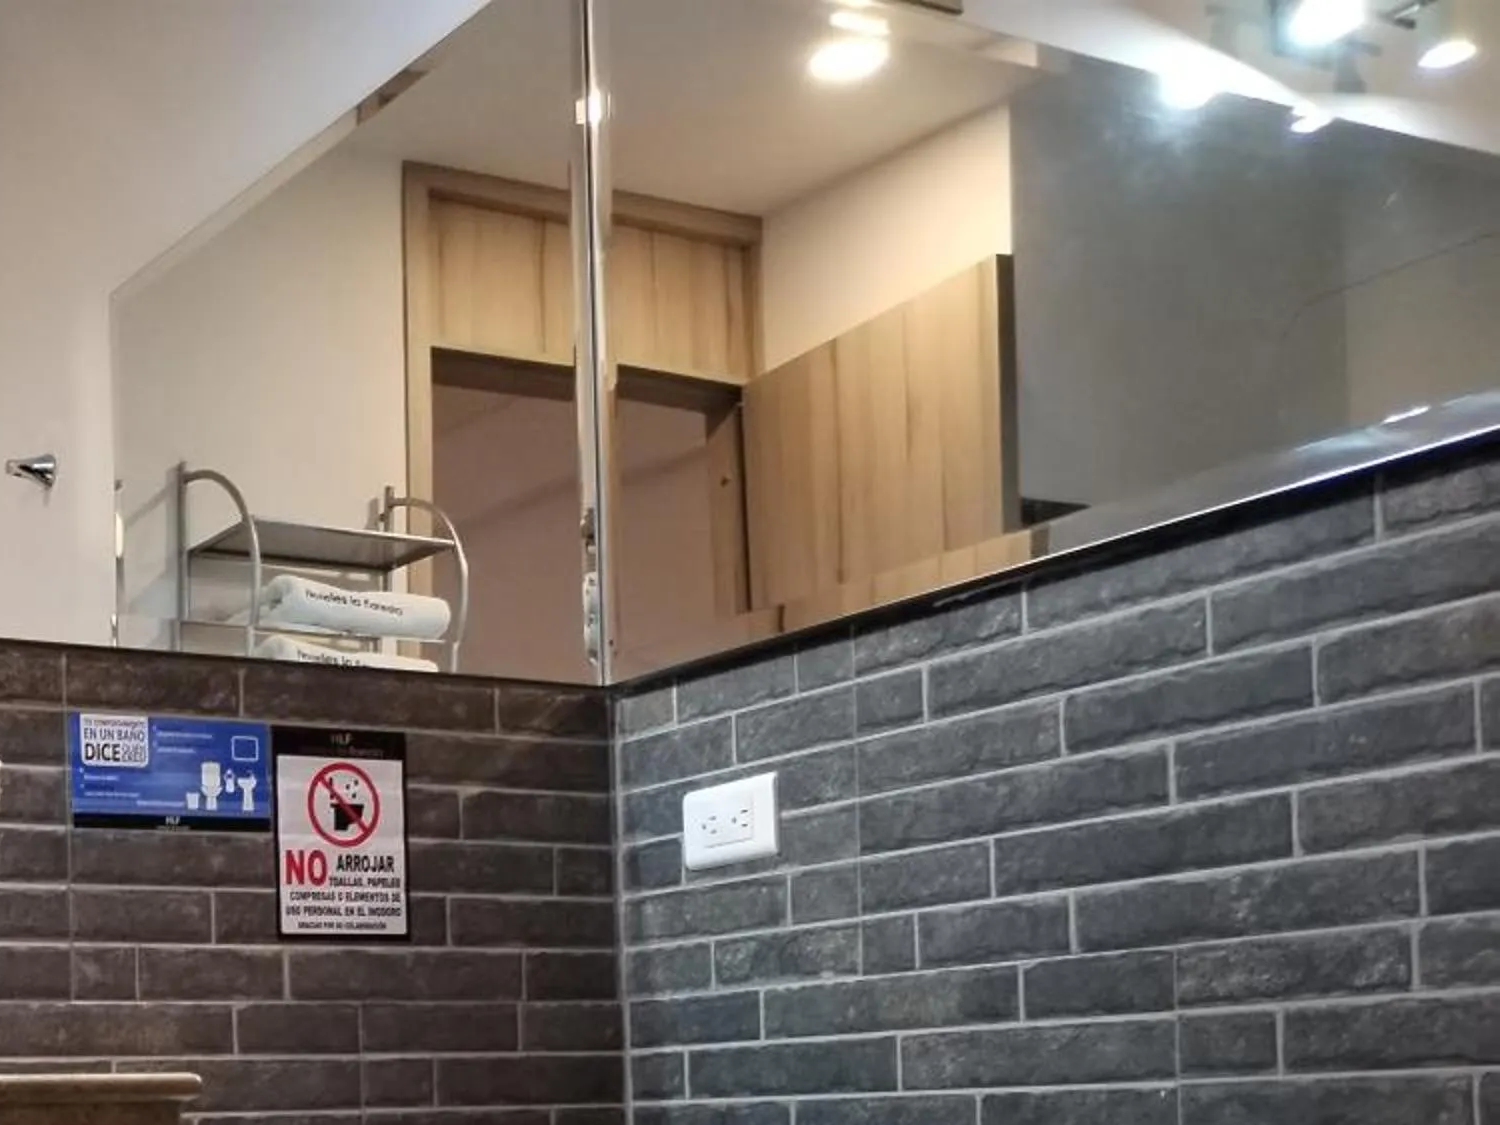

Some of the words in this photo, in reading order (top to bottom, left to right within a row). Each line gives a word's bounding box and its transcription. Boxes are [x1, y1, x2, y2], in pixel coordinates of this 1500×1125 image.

[83, 727, 97, 740] EN
[99, 727, 115, 741] UN
[285, 849, 327, 887] NO
[336, 854, 395, 873] ARROJAR
[345, 892, 389, 902] ELEMENTOS
[303, 905, 342, 916] PERSONAL
[344, 906, 355, 916] EN
